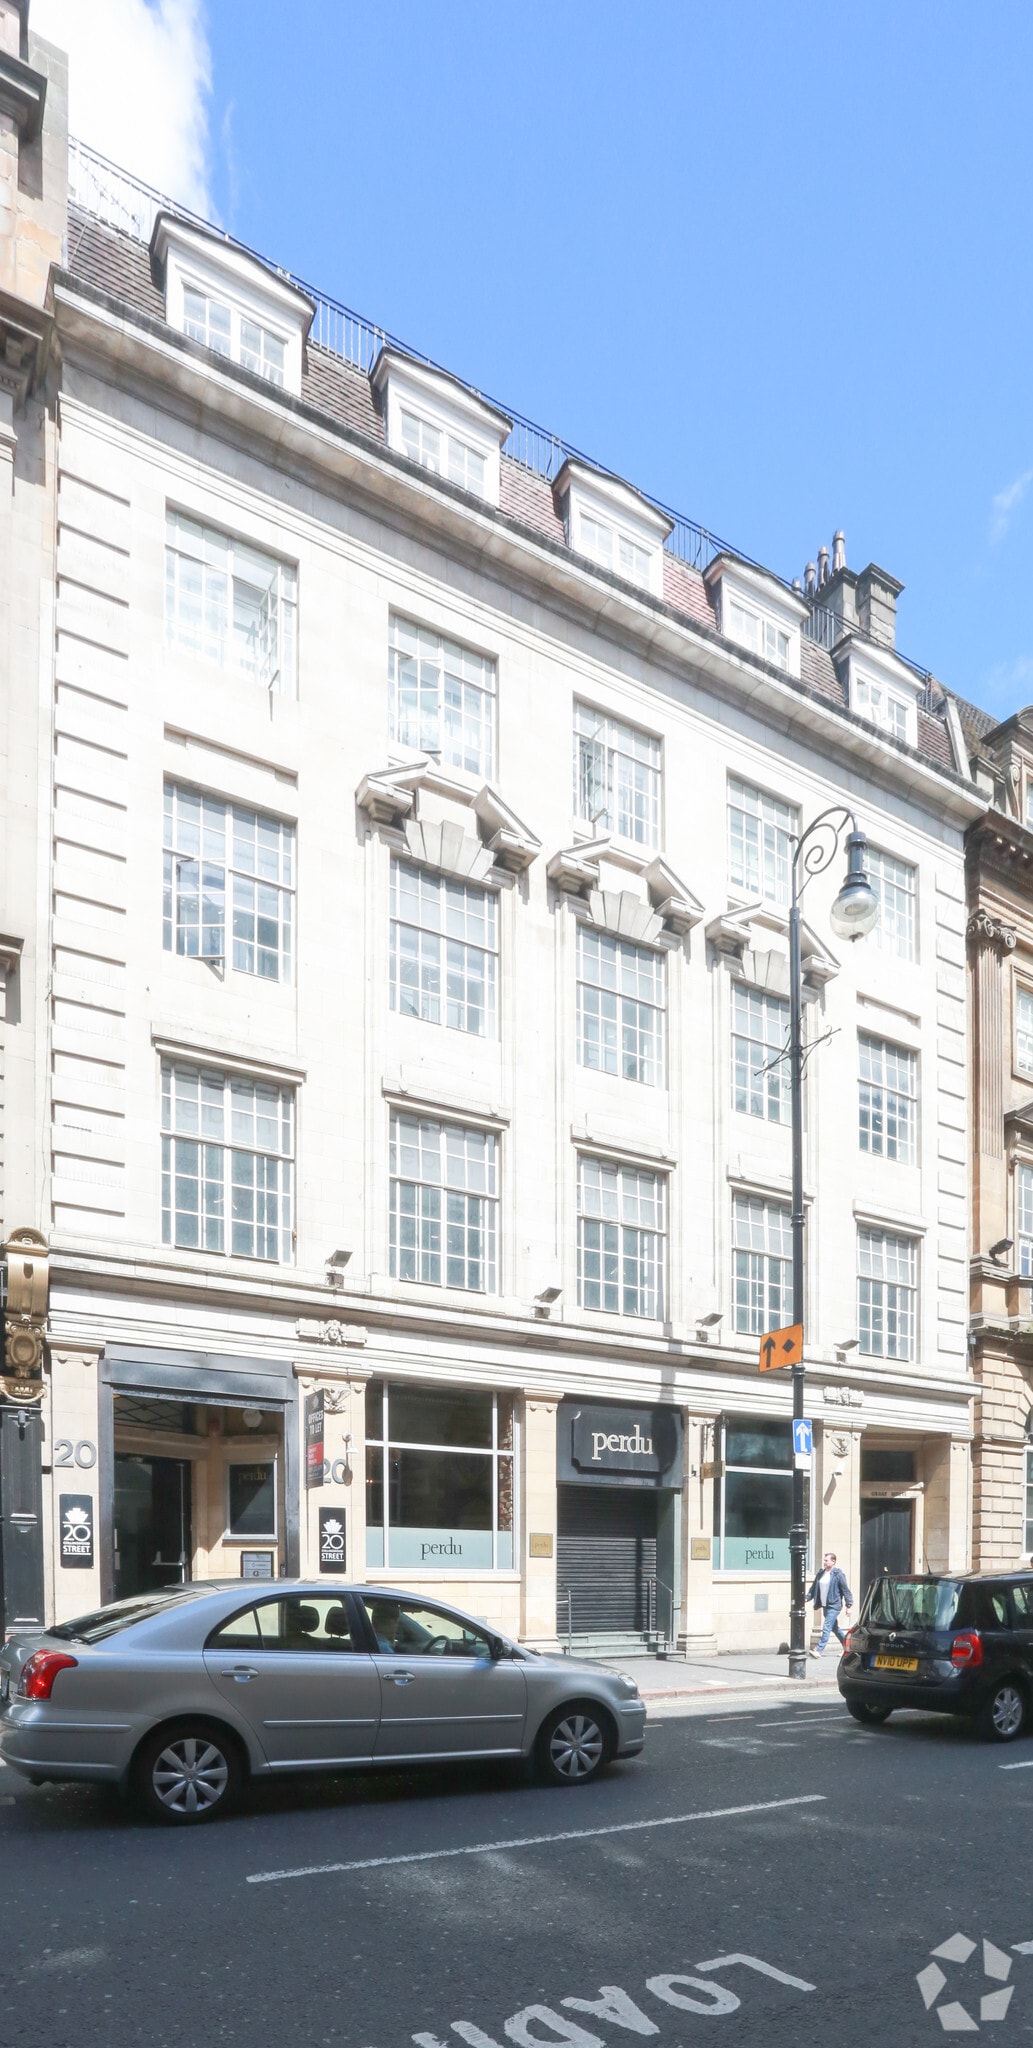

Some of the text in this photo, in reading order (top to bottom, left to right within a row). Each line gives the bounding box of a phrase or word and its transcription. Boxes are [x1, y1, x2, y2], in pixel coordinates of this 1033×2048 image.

[591, 1424, 654, 1460] perdu
[54, 1438, 97, 1469] 20
[63, 1524, 91, 1542] 20
[321, 1534, 344, 1549] 20
[62, 1545, 91, 1553] STREET
[321, 1552, 344, 1560] STREET
[420, 1536, 462, 1560] perdu
[744, 1543, 775, 1564] perdu
[876, 1655, 915, 1668] NV10 UPF
